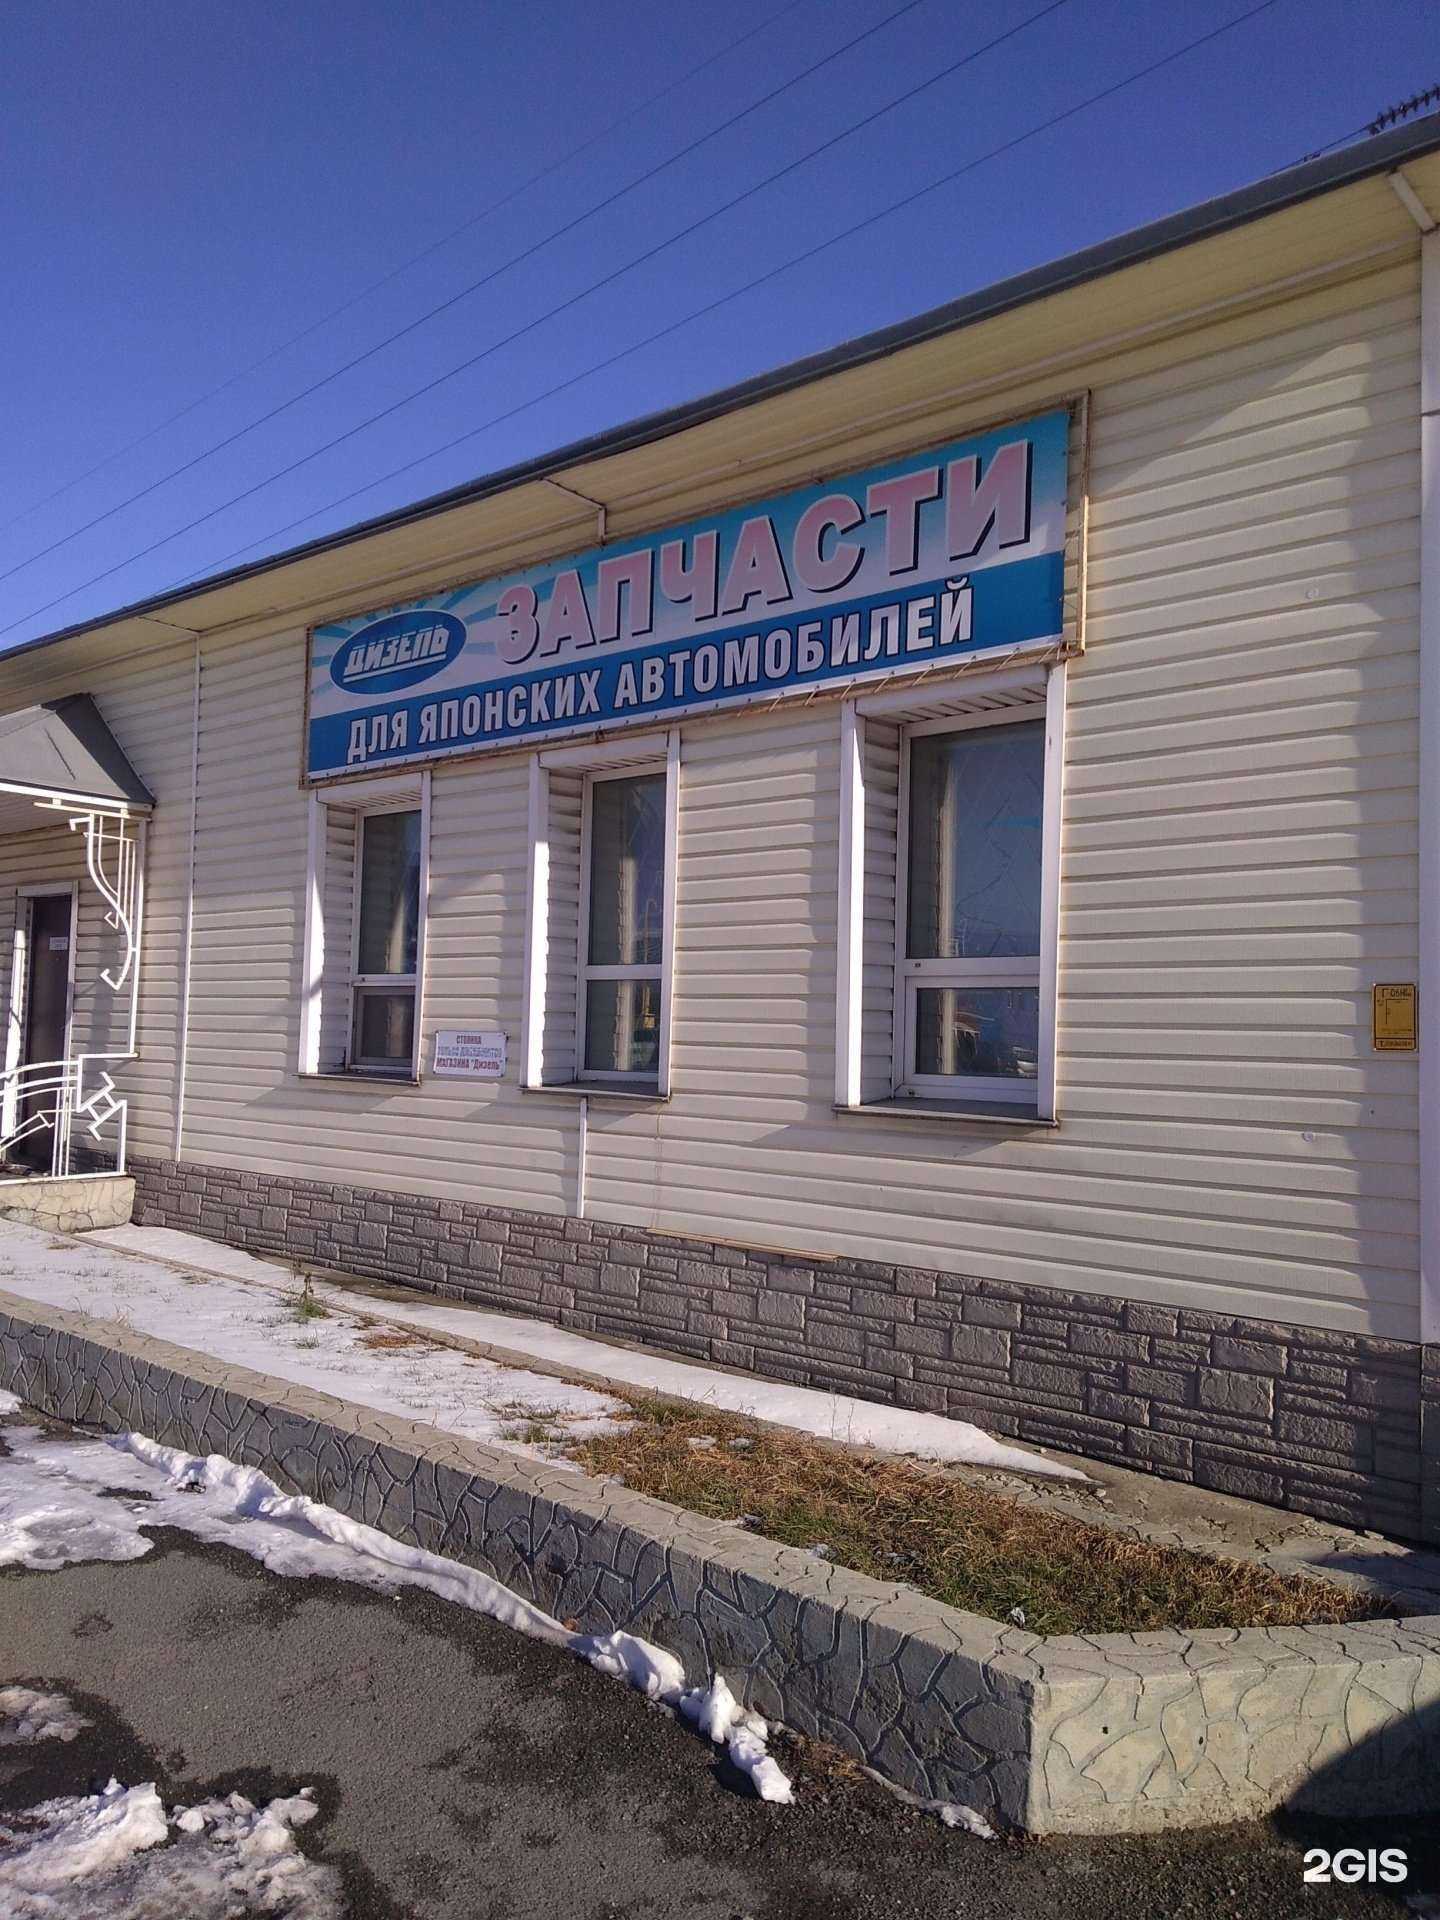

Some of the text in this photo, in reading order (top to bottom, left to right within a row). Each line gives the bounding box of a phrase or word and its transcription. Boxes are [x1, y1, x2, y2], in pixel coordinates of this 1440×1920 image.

[498, 438, 1034, 664] ЗАПЧАСТИ
[344, 624, 450, 675] ДИЗЕЛЬ
[346, 576, 975, 765] ДЛЯ ЯПОНСКИХ АВТОМОБИЛЕЙ
